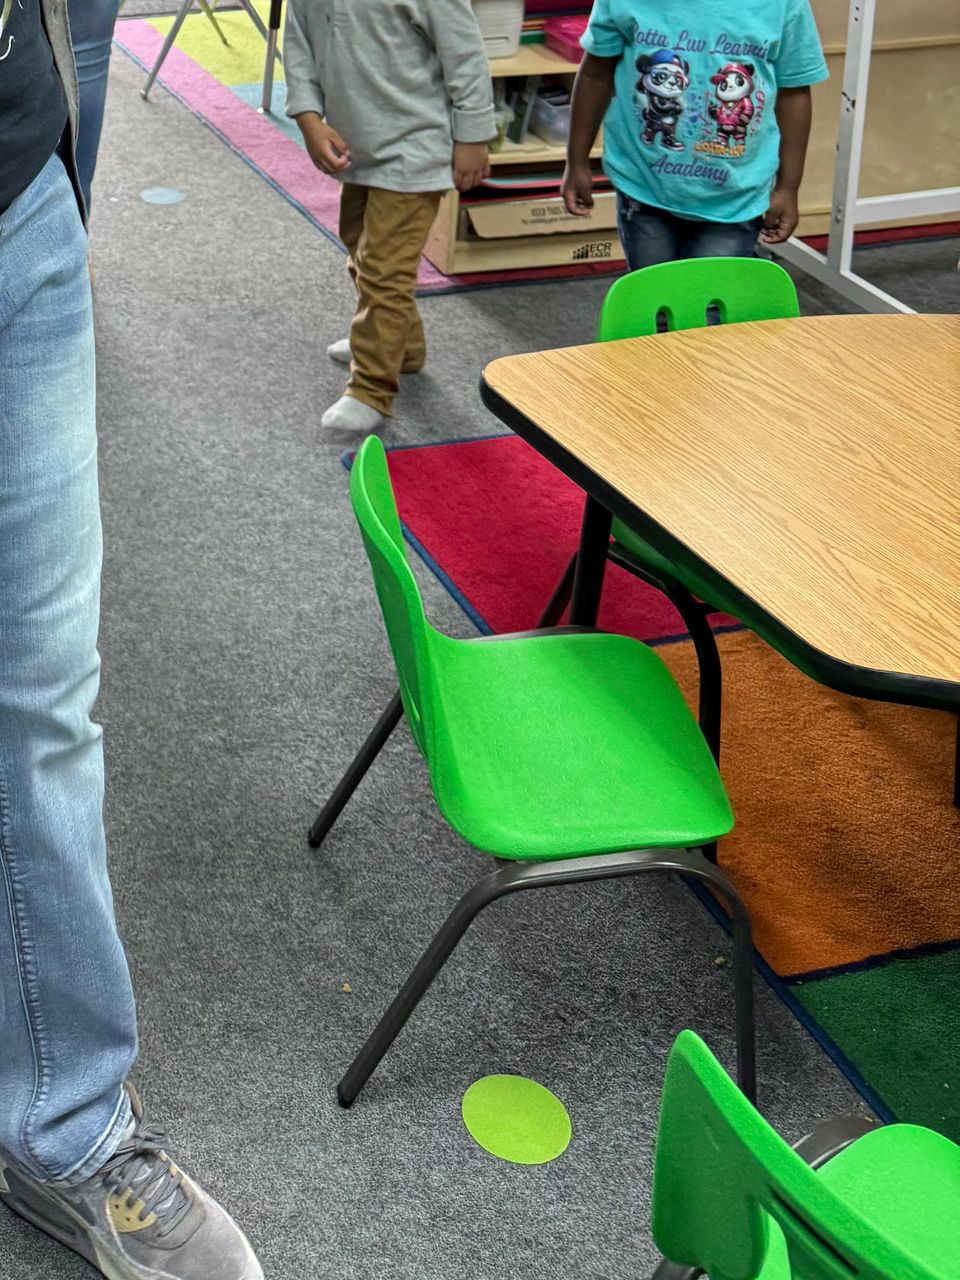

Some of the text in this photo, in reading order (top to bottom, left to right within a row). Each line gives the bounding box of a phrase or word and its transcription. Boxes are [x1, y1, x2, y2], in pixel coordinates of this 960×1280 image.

[670, 29, 707, 53] Luv
[709, 32, 769, 59] Learni
[649, 154, 731, 186] Academy
[589, 242, 612, 253] ECR
